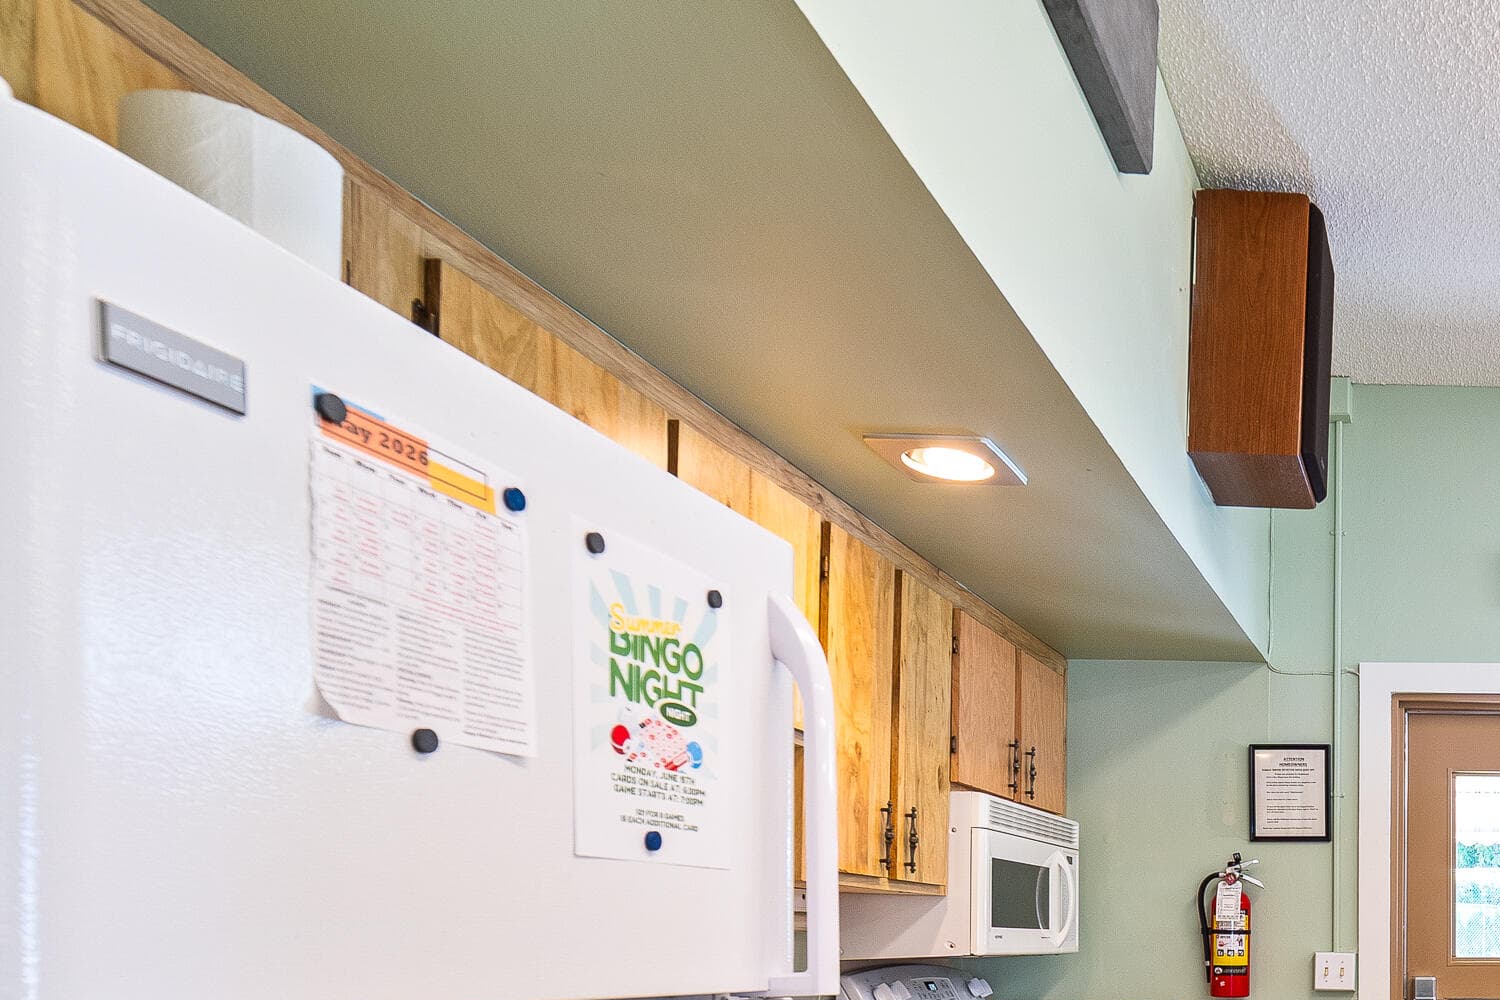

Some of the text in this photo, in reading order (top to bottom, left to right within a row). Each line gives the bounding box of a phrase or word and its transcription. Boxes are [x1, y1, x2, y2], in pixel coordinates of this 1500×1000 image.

[111, 323, 243, 393] FRIGIDAIRE
[380, 432, 429, 466] 2026
[609, 629, 703, 681] BINGO
[609, 657, 704, 708] NIGHT
[610, 772, 637, 784] CARDS
[639, 777, 649, 786] ON
[650, 779, 668, 791] SALE
[624, 765, 657, 778] MONDAY,
[660, 772, 678, 782] JUNE
[613, 784, 637, 796] GAME
[638, 787, 666, 801] STARTS
